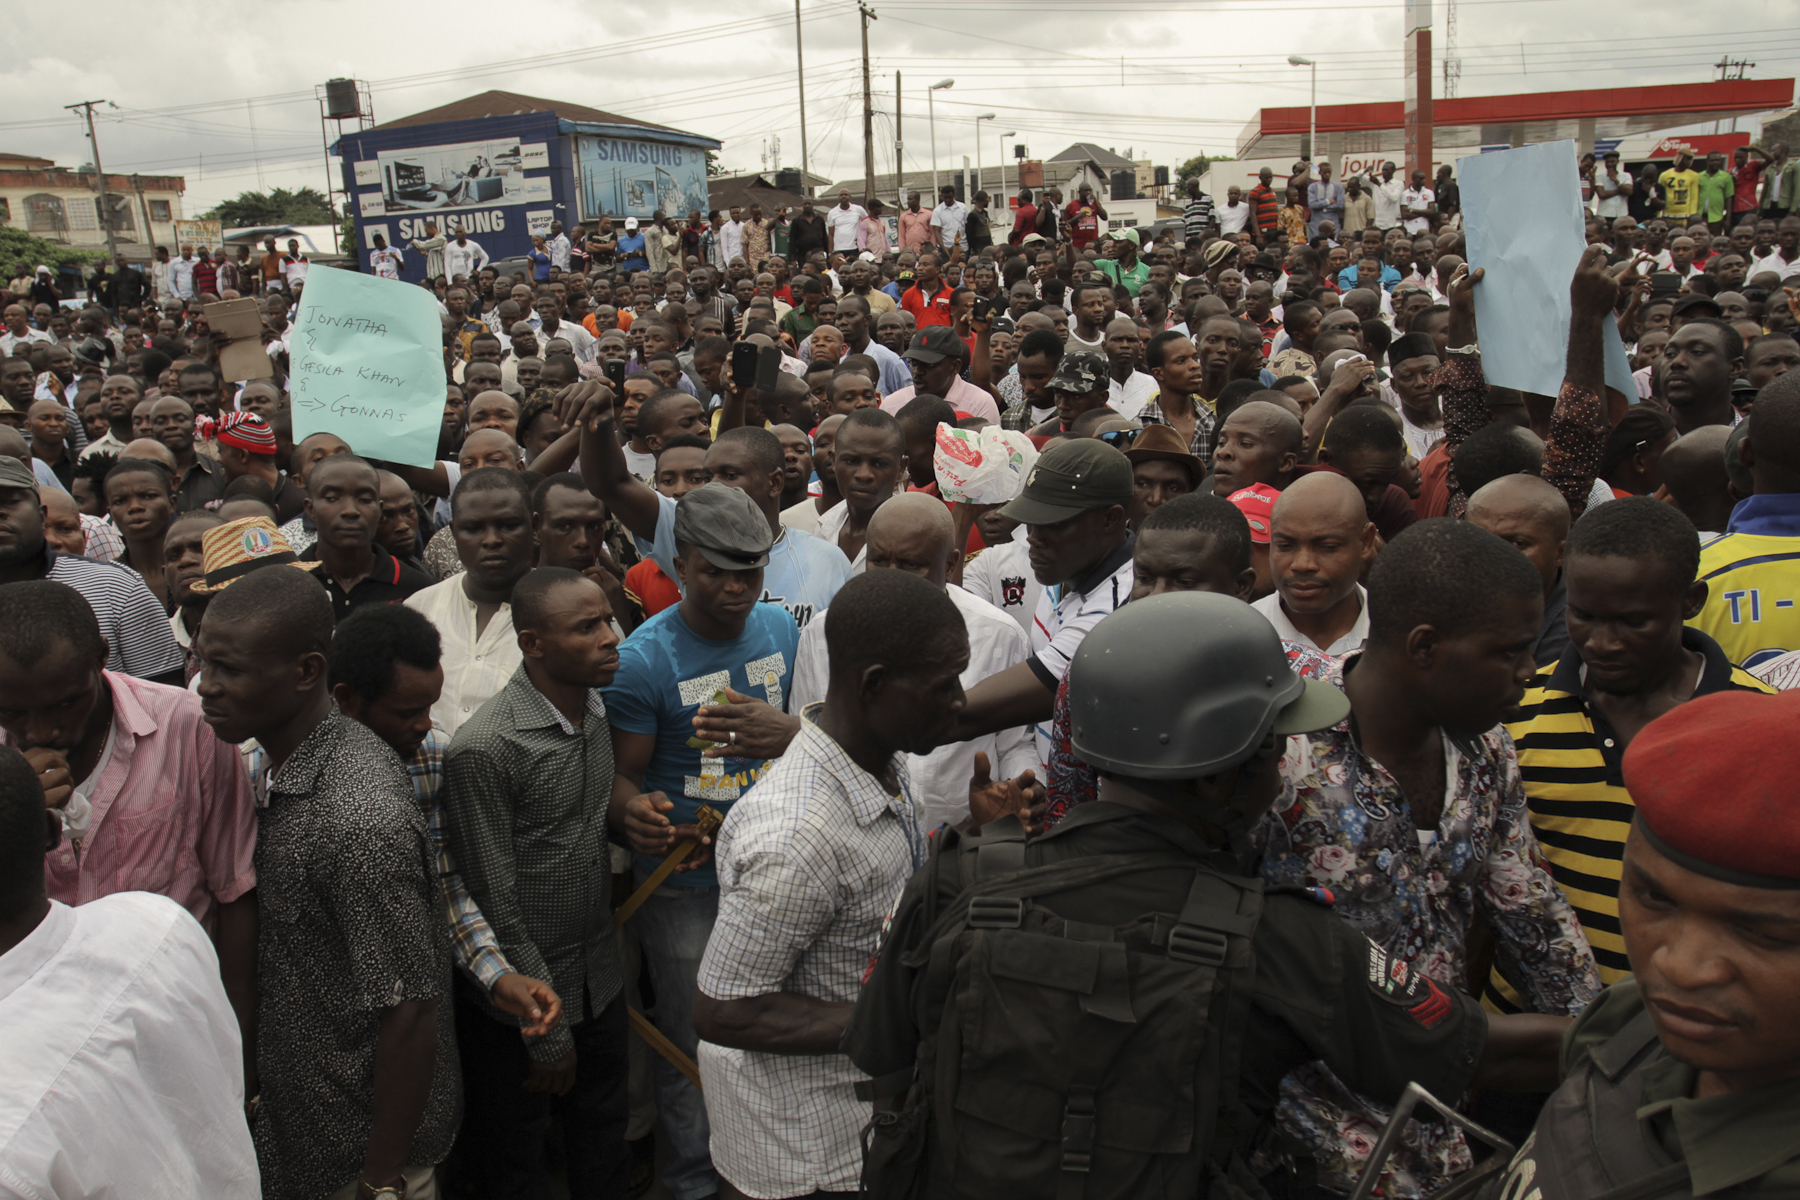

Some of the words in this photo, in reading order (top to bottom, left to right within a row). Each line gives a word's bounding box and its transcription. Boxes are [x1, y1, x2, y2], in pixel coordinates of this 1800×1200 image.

[597, 138, 682, 167] SAMSUNG
[399, 209, 505, 240] SAMSUNG
[527, 216, 553, 224] LAPTOP
[356, 366, 406, 387] KHAN
[1723, 588, 1761, 624] TI
[766, 672, 777, 684] H
